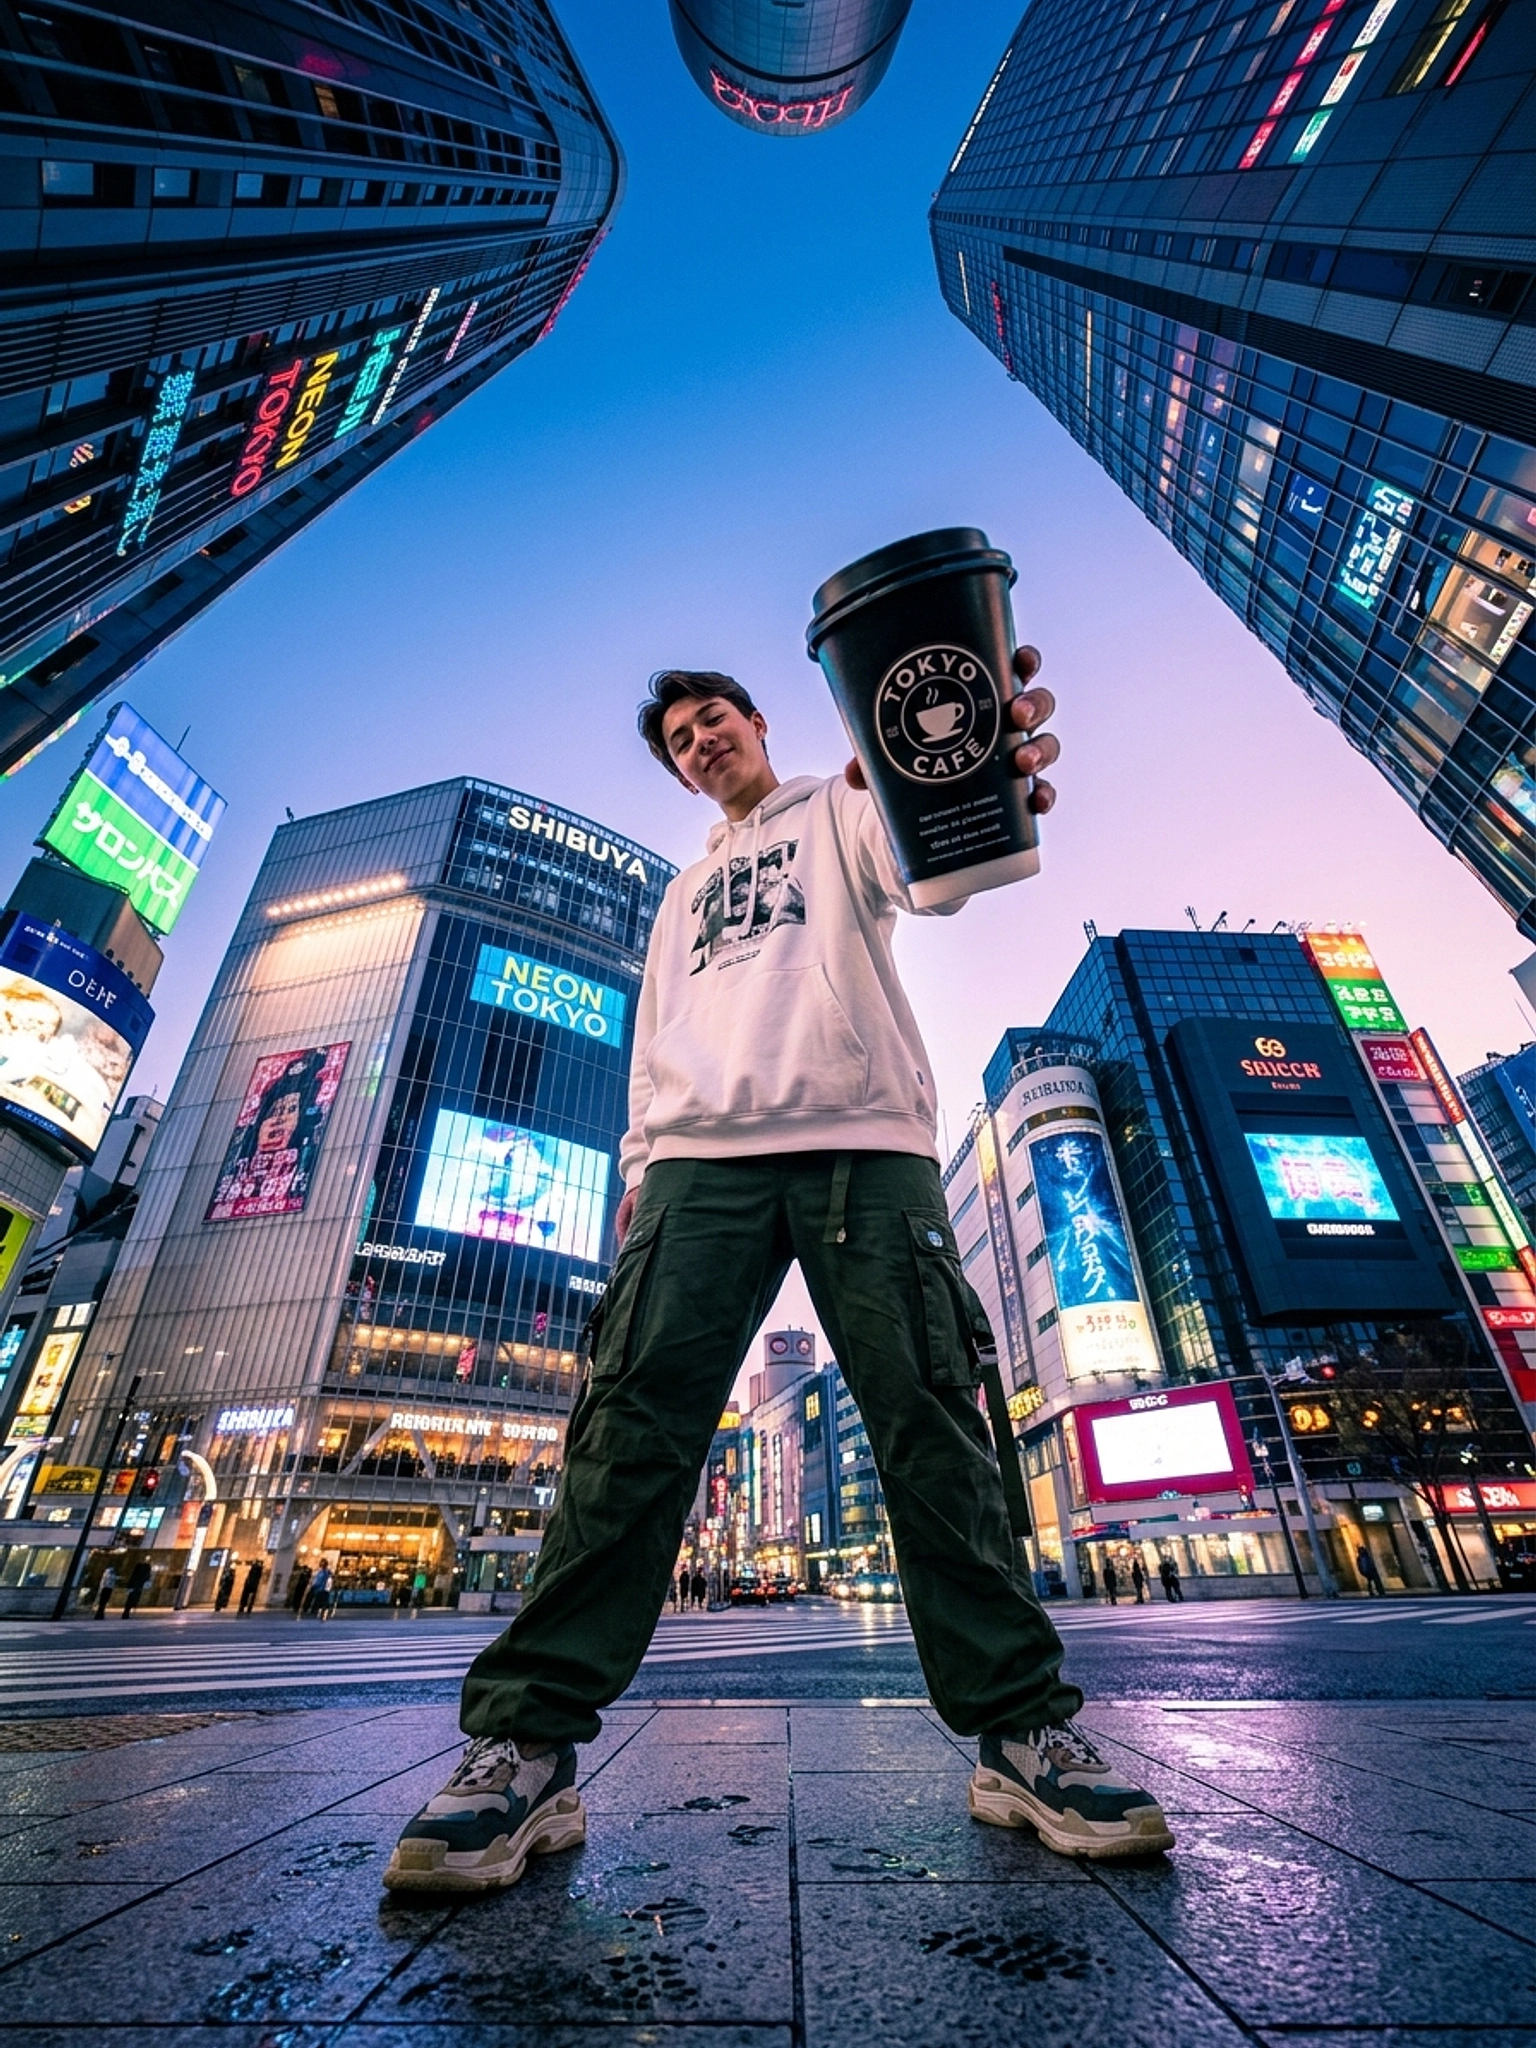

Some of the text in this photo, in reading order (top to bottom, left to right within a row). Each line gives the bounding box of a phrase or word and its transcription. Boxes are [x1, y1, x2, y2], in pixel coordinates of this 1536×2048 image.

[231, 359, 303, 497] TOKYO
[276, 351, 339, 469] NEON
[886, 653, 977, 703] TOKYO
[508, 805, 648, 884] SHIBUYA
[491, 979, 607, 1038] TOKYO
[502, 956, 604, 1012] NEON
